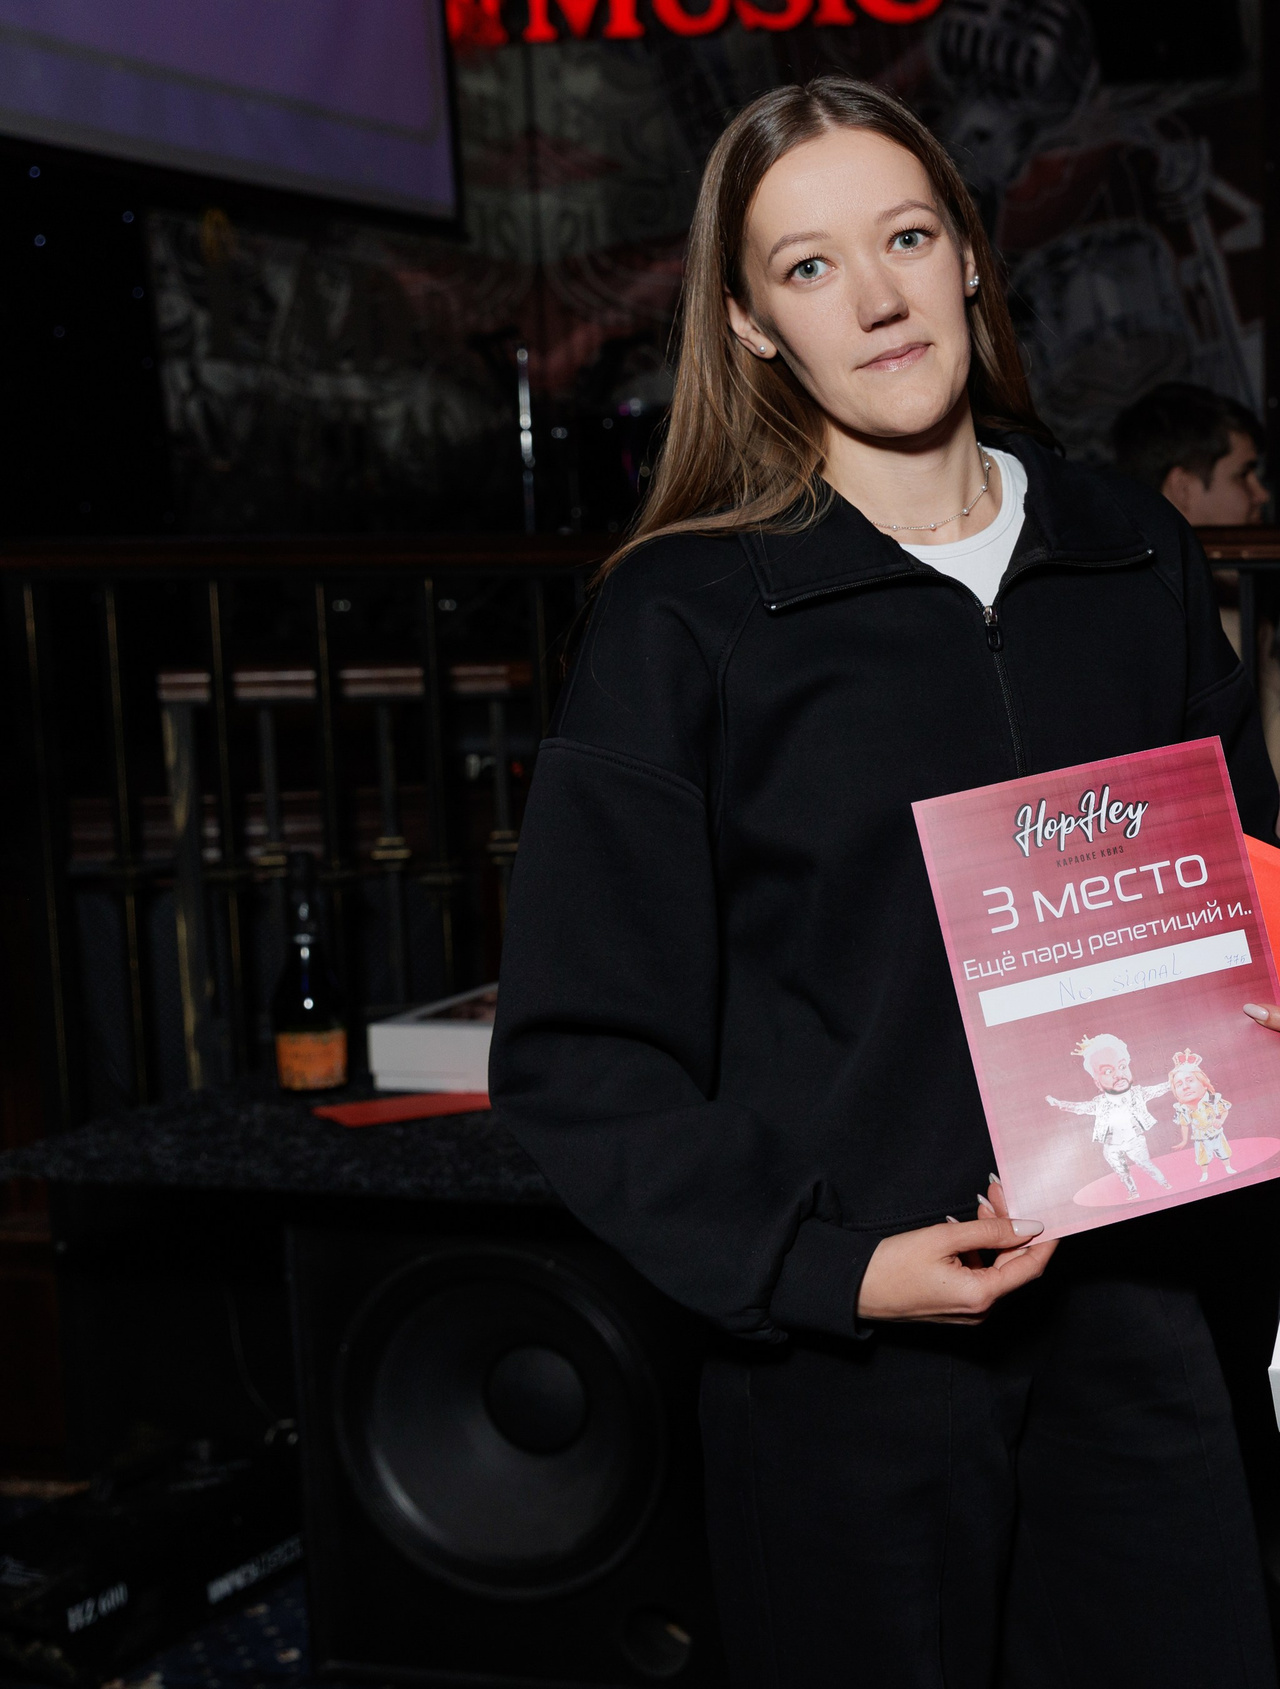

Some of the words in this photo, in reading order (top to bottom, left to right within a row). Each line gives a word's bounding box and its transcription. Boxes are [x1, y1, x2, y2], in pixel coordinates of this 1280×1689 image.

[1056, 852, 1097, 868] КАРАОКЕ
[1100, 845, 1125, 858] КВИЗ
[982, 886, 1020, 934] 3
[963, 950, 1017, 980] Ещё
[1021, 939, 1083, 964] пару
[1088, 900, 1223, 955] репетиций
[1059, 977, 1093, 1006] No
